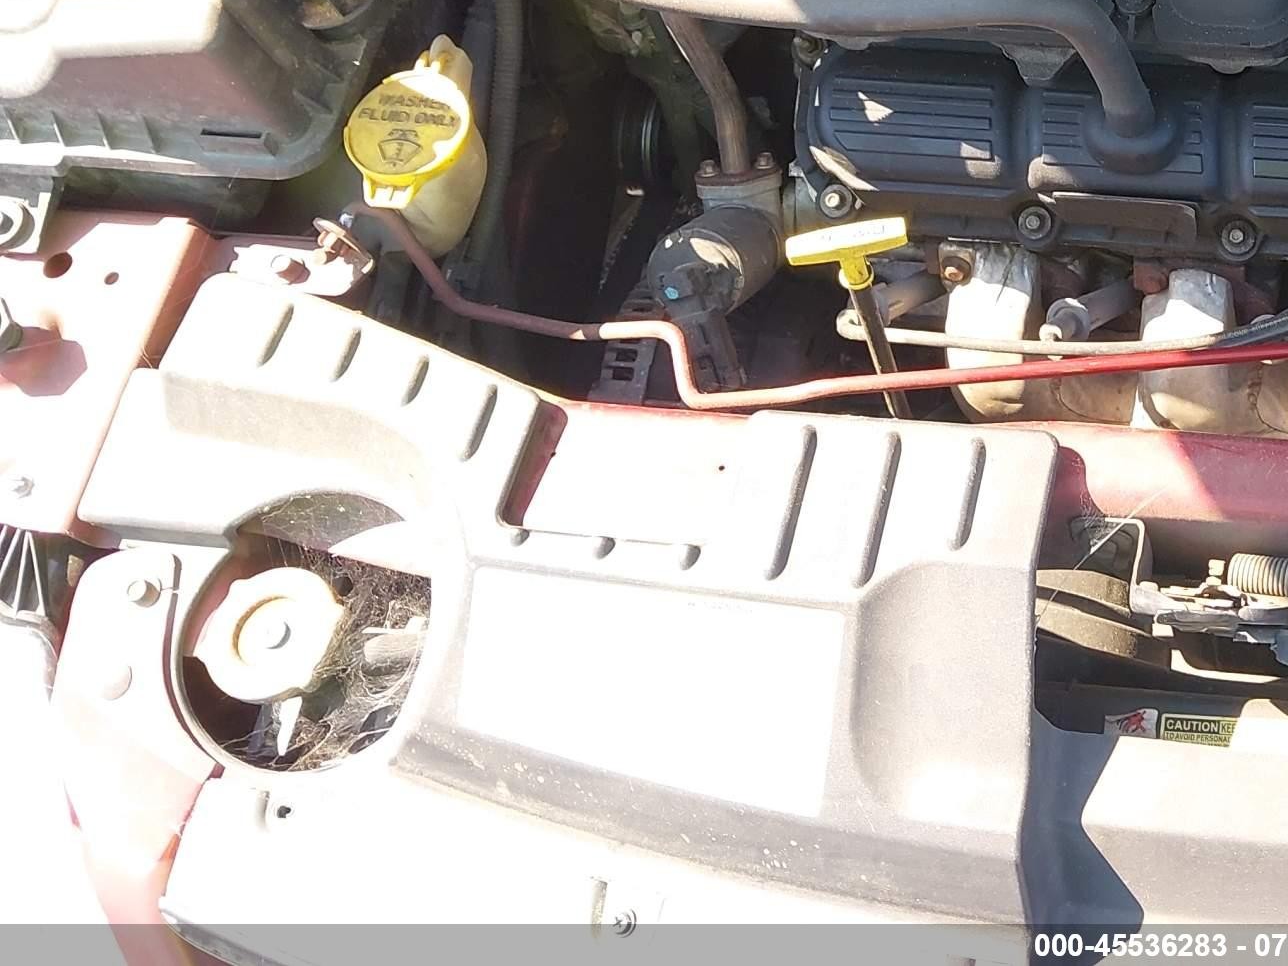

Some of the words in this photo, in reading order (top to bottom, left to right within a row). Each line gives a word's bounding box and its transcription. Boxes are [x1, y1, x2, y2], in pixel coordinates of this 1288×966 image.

[358, 108, 410, 123] FLUID
[1166, 720, 1219, 732] CAUTION
[1175, 733, 1195, 741] AVOID
